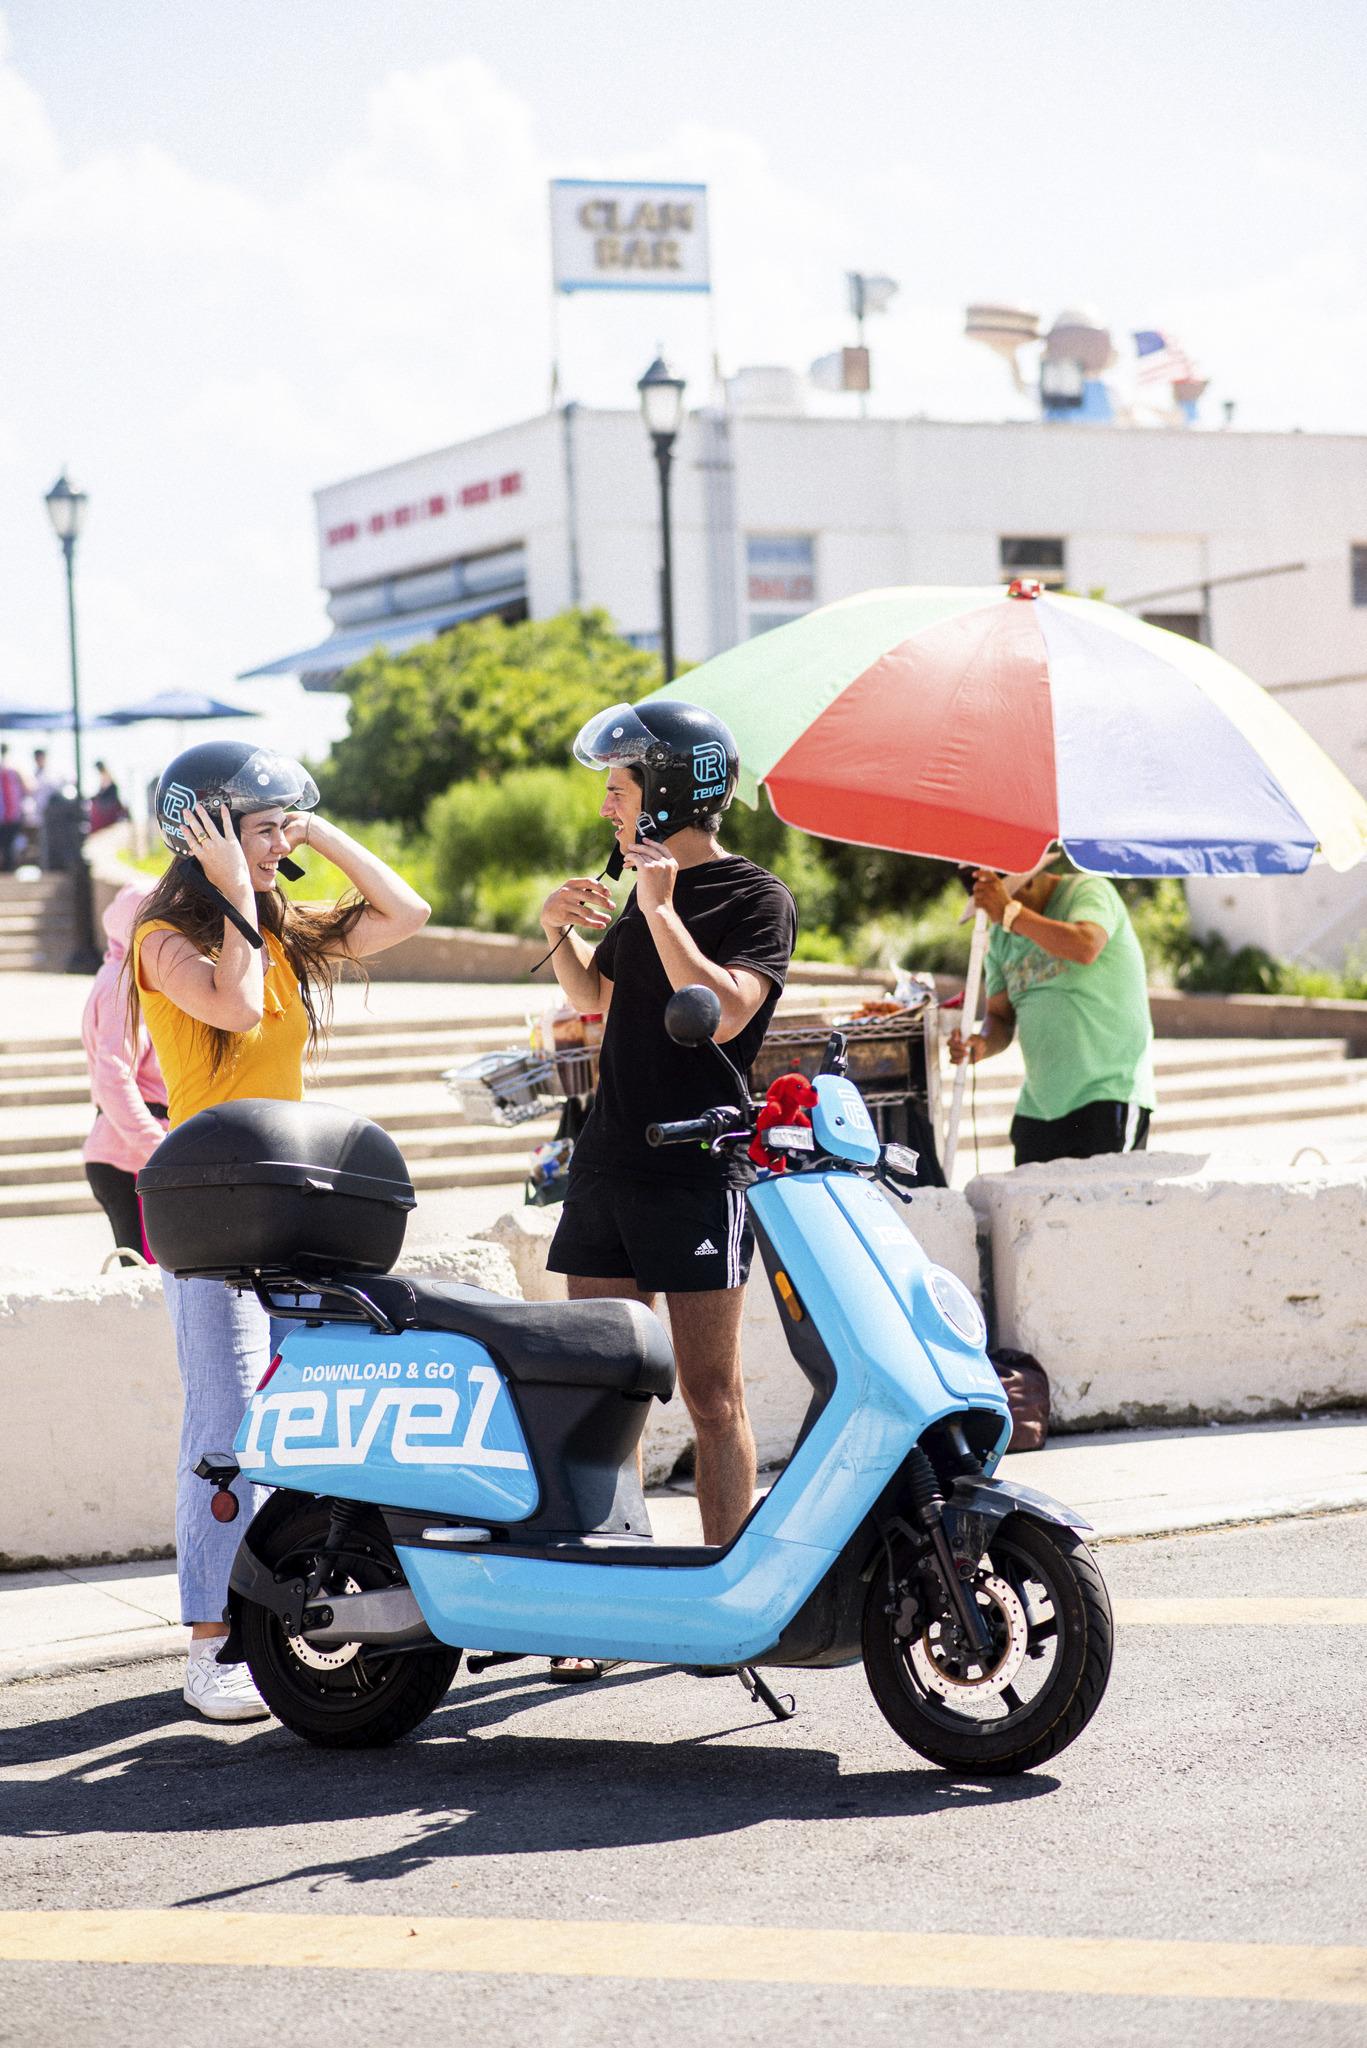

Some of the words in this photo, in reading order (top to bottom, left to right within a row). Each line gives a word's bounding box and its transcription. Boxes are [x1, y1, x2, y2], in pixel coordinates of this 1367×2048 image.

[594, 237, 682, 270] BAR
[692, 780, 726, 800] revel
[161, 821, 187, 840] reve
[694, 1248, 718, 1256] adidas
[302, 1362, 401, 1383] DOWNLOAD
[406, 1362, 419, 1379] &
[424, 1361, 455, 1379] GO
[234, 1365, 529, 1470] revel
